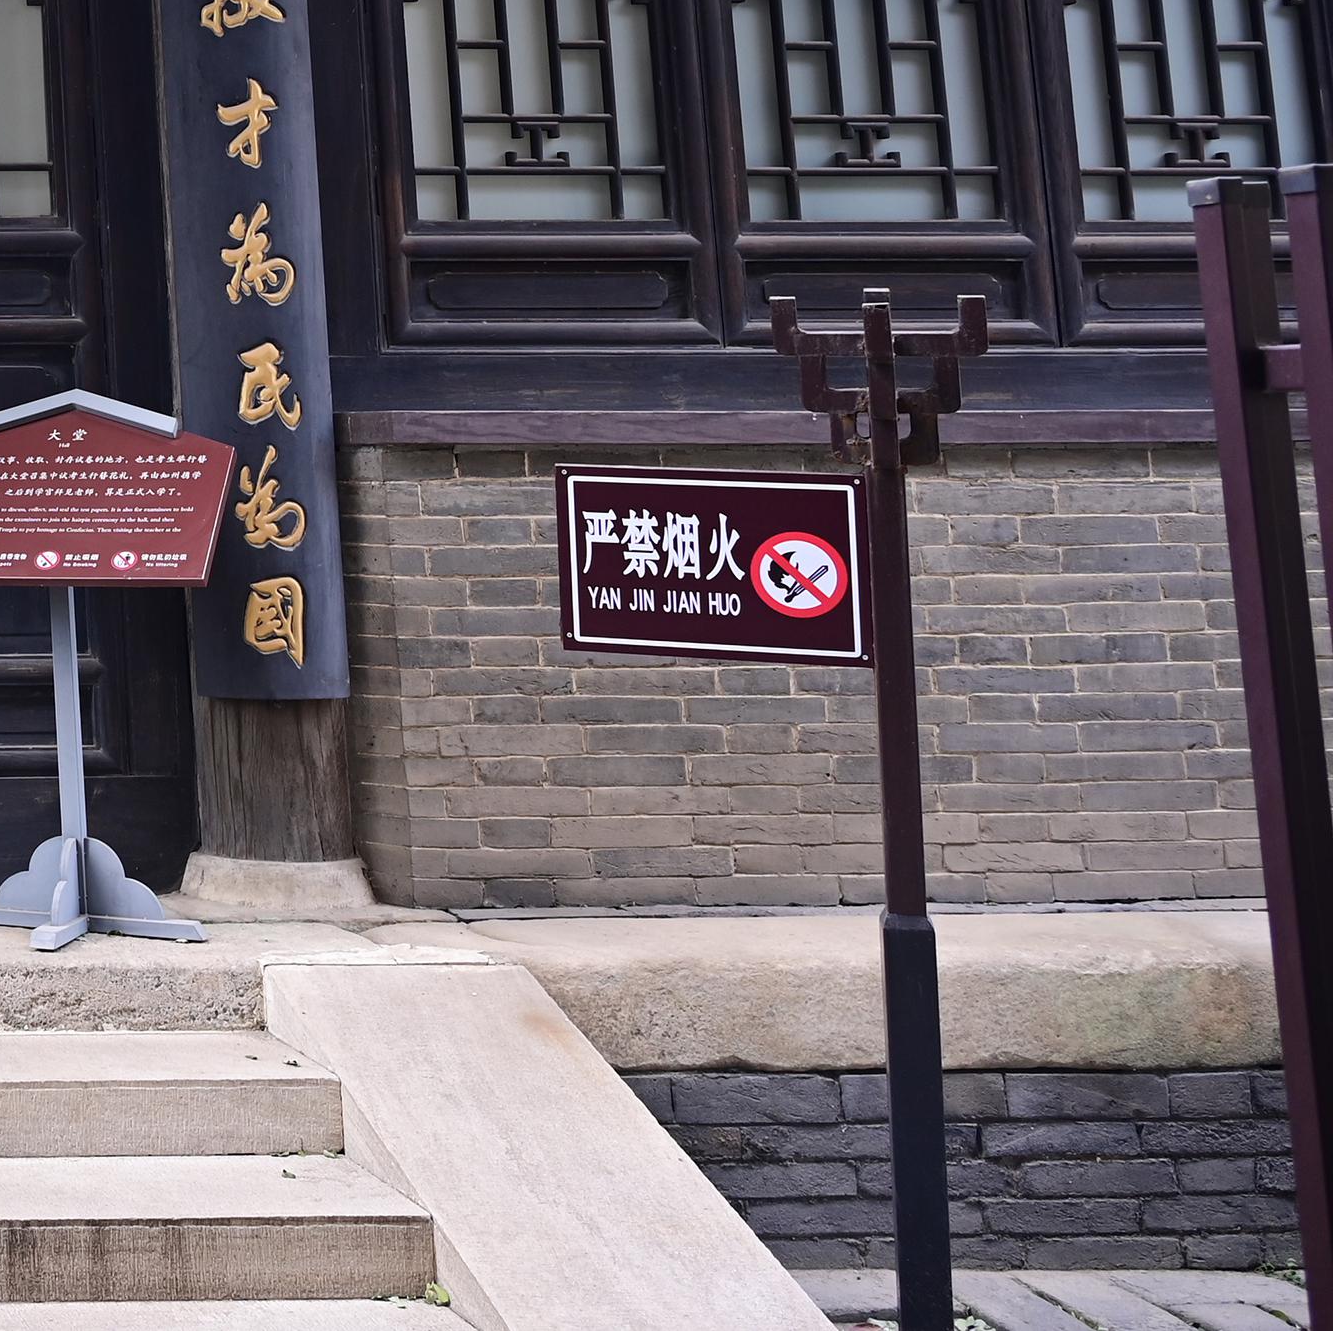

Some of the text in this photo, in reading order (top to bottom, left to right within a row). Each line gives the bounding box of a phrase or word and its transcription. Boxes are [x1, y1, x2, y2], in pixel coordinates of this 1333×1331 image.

[47, 428, 88, 442] 大堂
[582, 508, 745, 581] 严禁烟火
[587, 585, 741, 616] YAN JIN JIAN HUO
